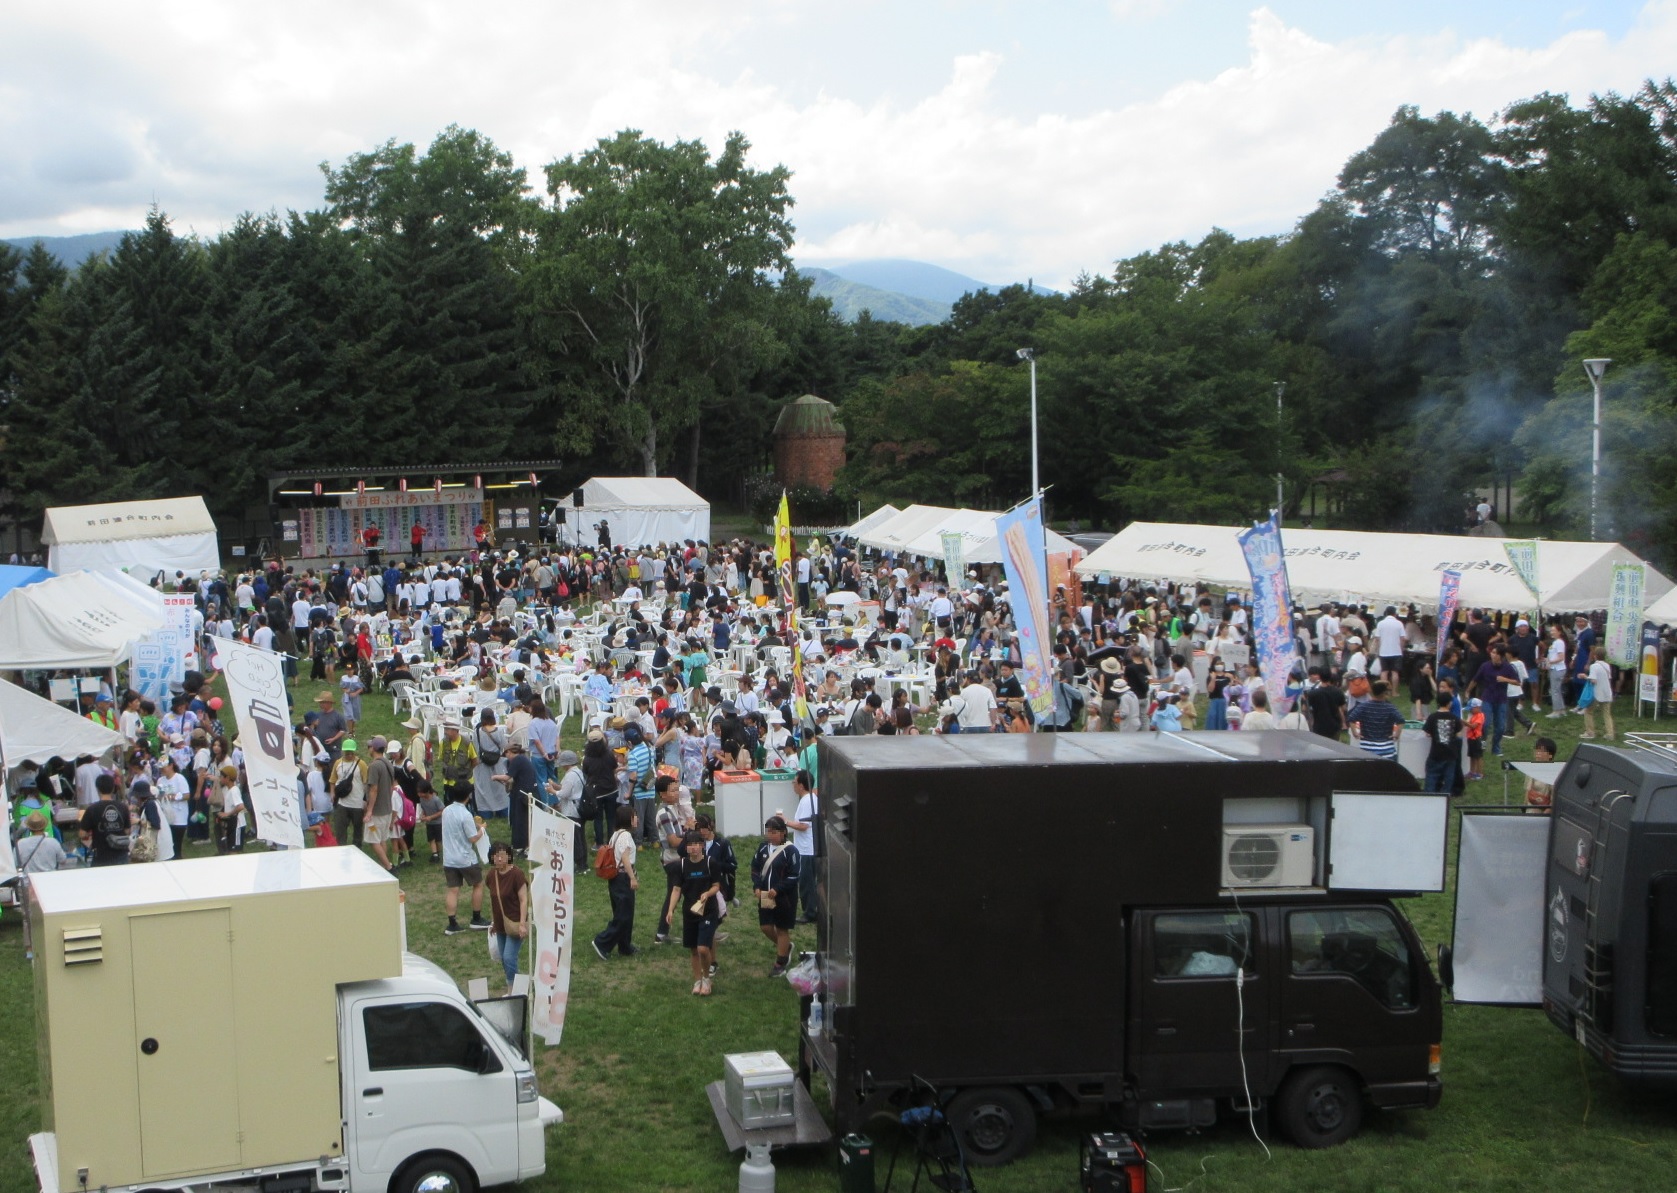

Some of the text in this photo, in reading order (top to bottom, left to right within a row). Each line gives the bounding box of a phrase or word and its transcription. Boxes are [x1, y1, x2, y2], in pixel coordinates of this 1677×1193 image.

[356, 490, 466, 507] 前田ふれあいまつり
[1283, 546, 1361, 561] 田連合町内会
